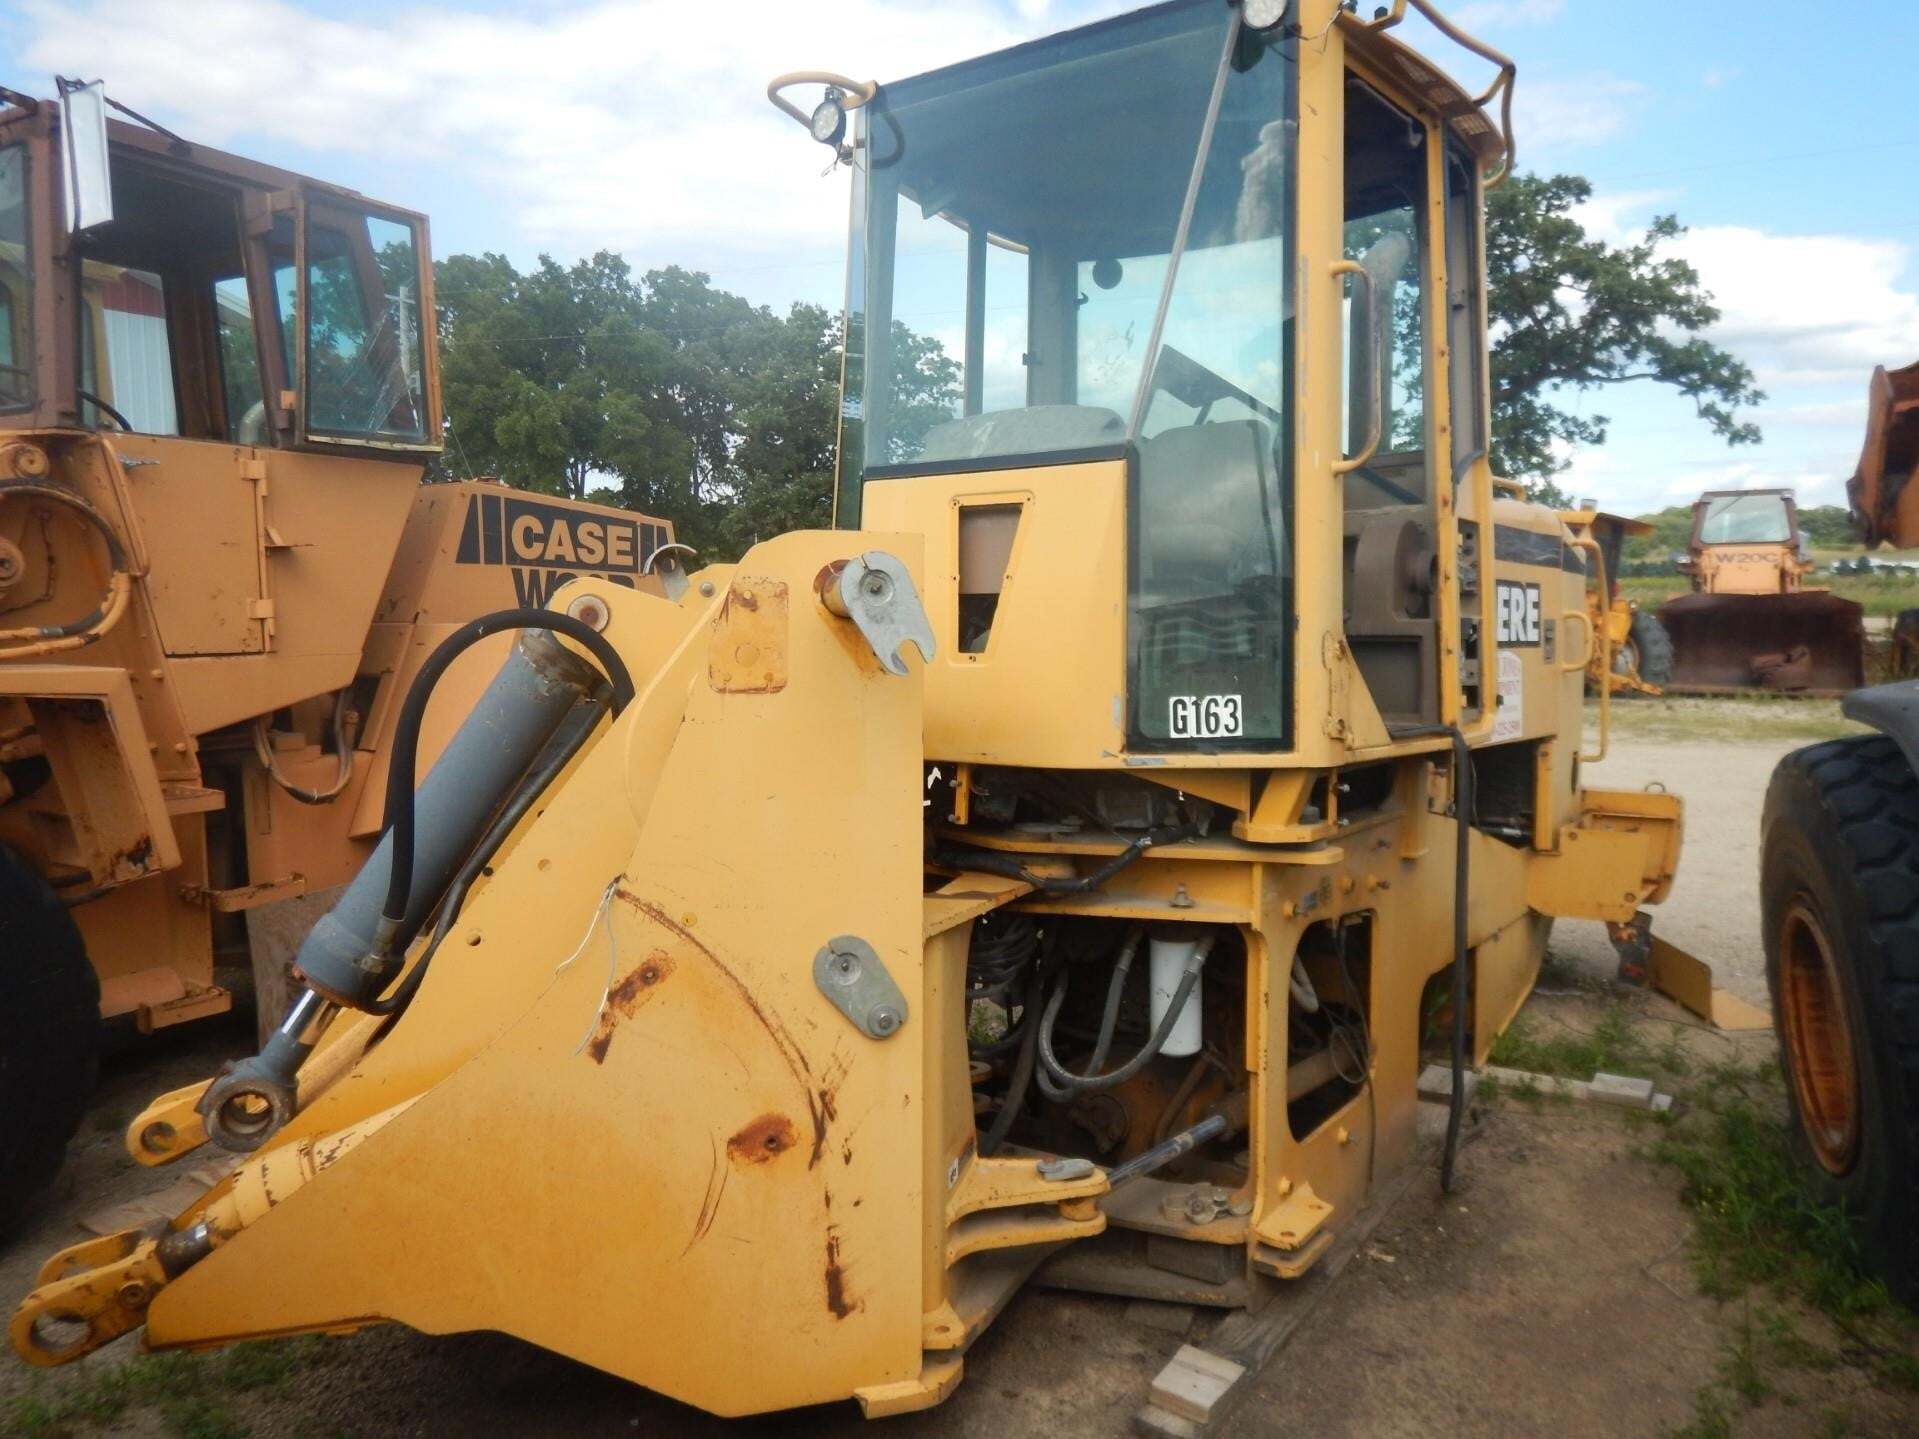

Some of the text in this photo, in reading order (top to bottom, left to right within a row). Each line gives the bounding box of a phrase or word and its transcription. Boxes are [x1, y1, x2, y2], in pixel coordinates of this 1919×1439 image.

[511, 515, 633, 566] CASE
[1716, 552, 1779, 563] W20C
[1172, 698, 1239, 735] G163
